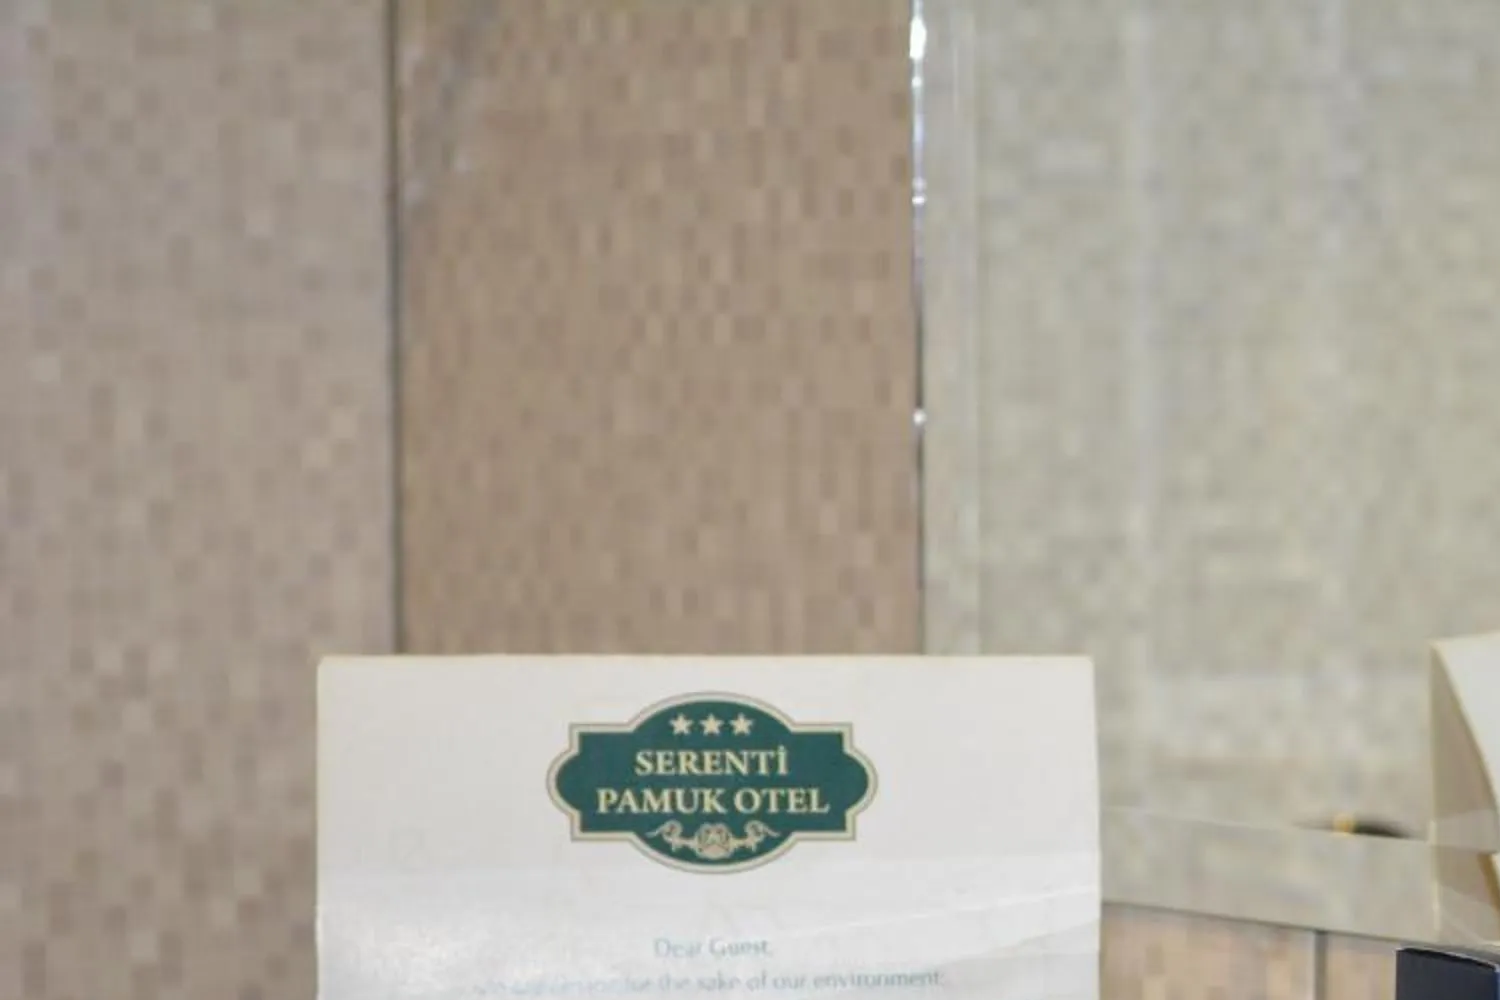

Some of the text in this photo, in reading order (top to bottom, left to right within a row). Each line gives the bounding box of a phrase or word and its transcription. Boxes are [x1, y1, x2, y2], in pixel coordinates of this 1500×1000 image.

[634, 745, 790, 776] SERENTİ
[596, 787, 831, 815] PAMUK OTEL
[653, 938, 703, 958] Dear
[697, 969, 741, 991] sake
[745, 969, 769, 992] of
[772, 974, 807, 990] our
